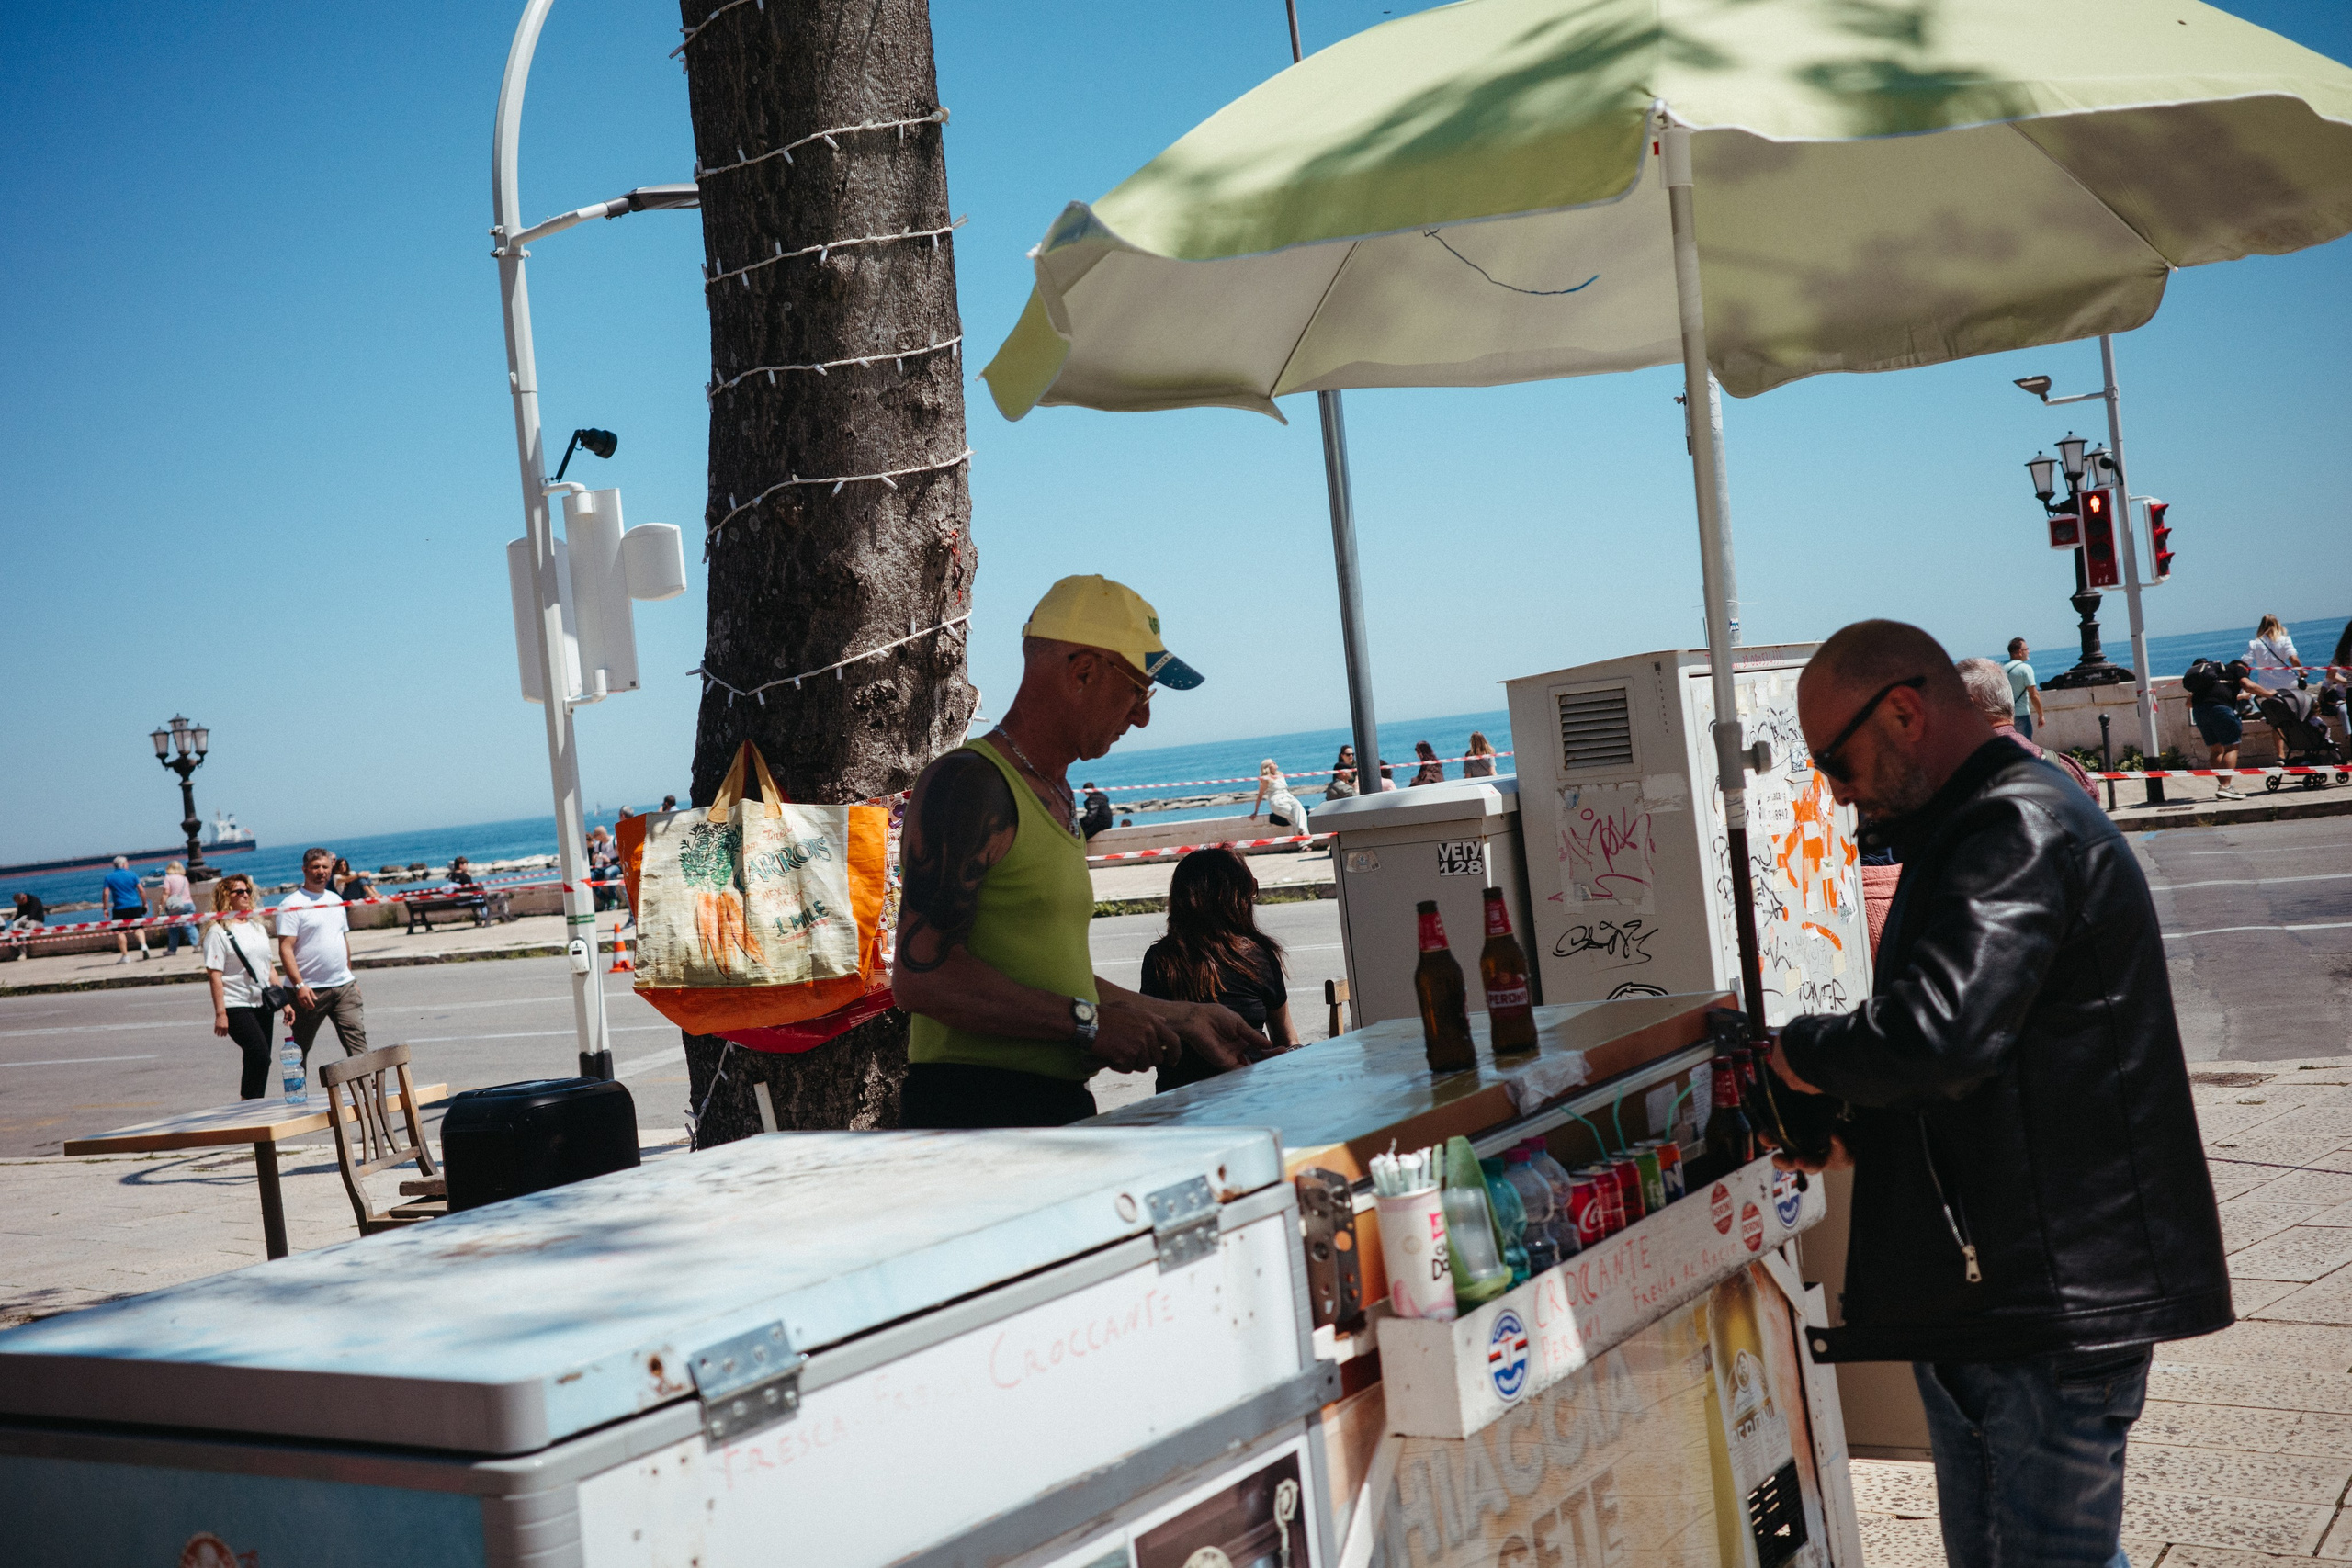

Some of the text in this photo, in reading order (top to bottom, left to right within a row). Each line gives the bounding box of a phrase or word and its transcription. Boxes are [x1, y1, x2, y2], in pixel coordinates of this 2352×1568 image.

[733, 836, 831, 894] CARROTS
[1440, 861, 1483, 876] 128
[789, 900, 829, 931] MILE
[1534, 1235, 1652, 1328] CROCCANTE
[989, 1288, 1175, 1390] CROCCANTE
[1541, 1315, 1601, 1378] PERONI
[721, 1416, 850, 1491] FRESCA
